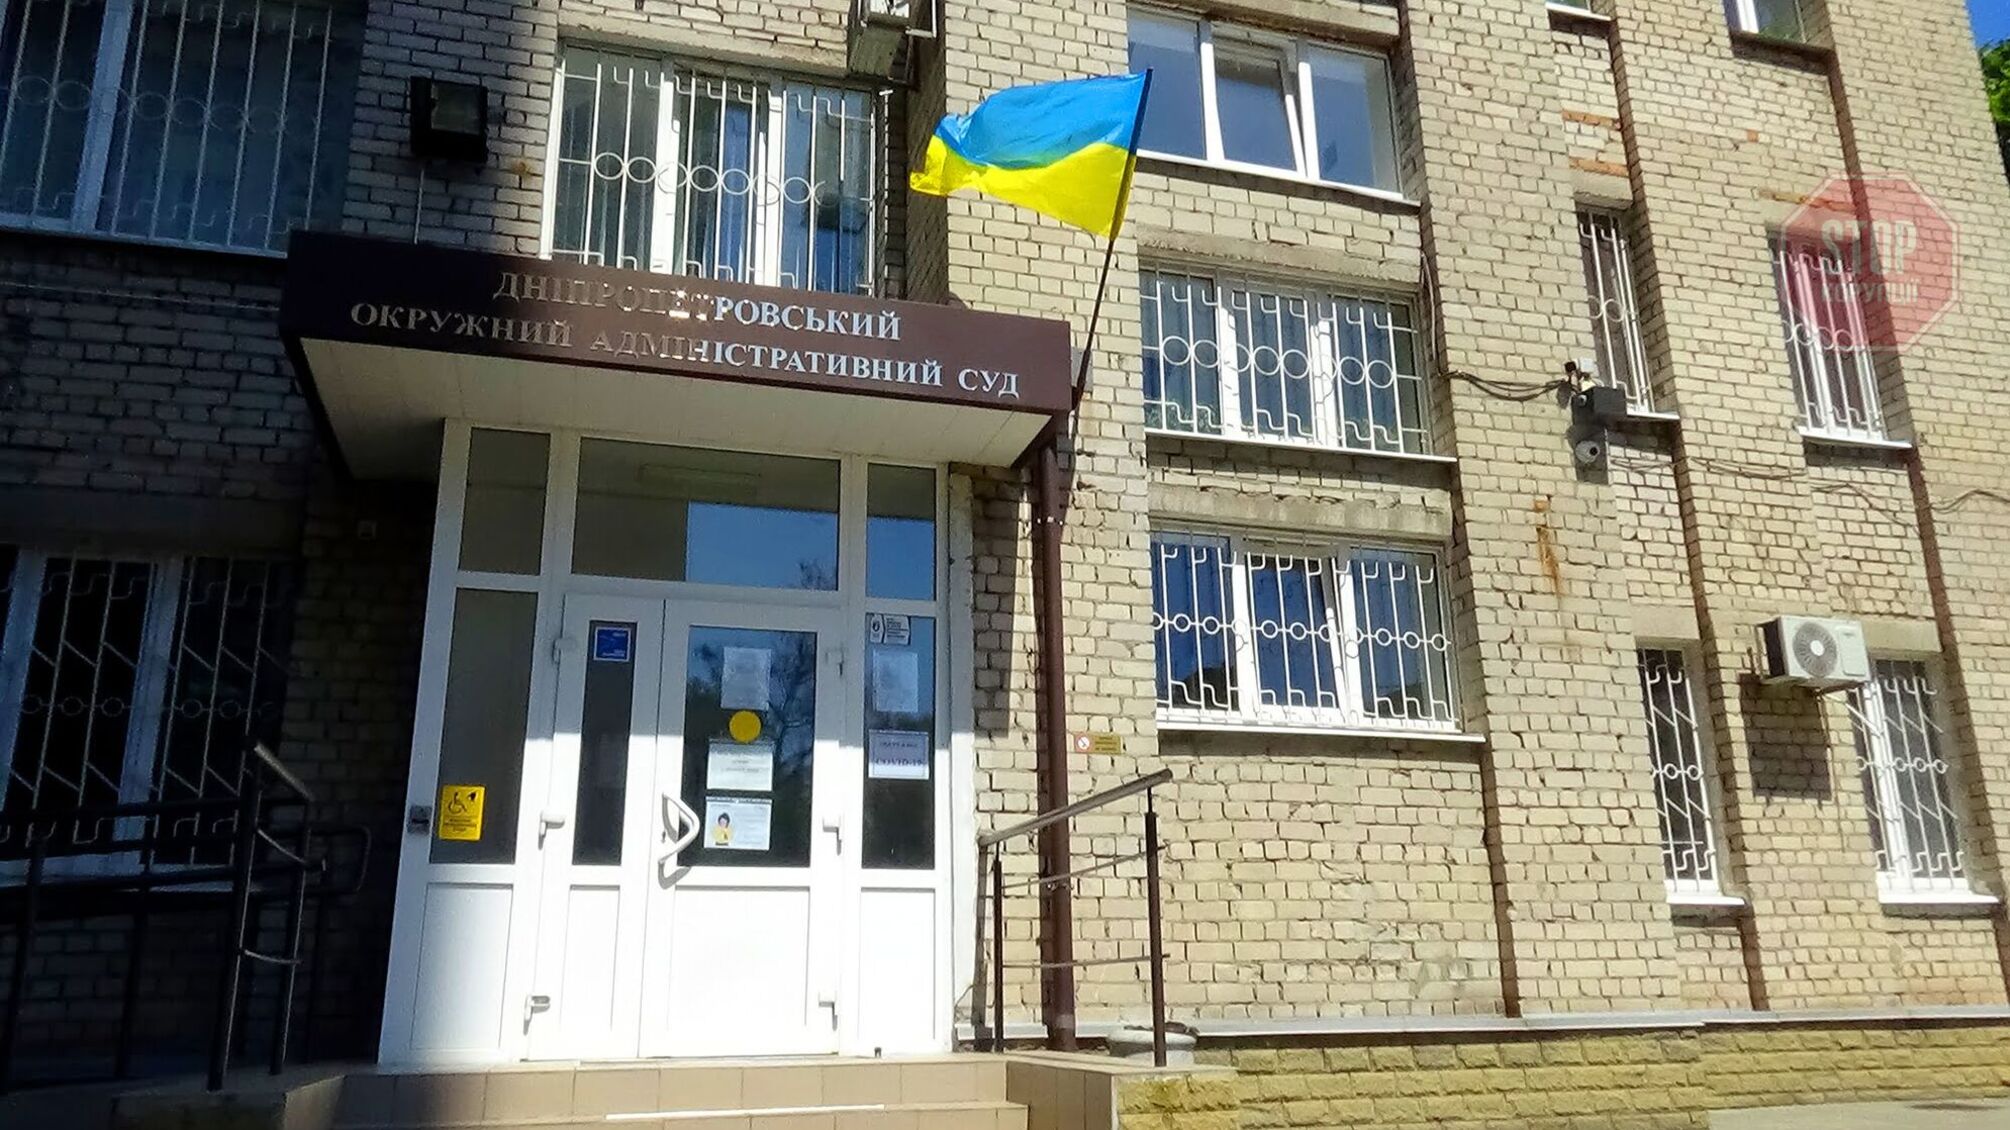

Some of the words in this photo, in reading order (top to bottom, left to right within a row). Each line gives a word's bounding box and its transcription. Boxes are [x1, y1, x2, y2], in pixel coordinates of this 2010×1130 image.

[493, 272, 901, 341] ДНІПРОПЕТРОВСЬКИЙ
[351, 302, 572, 348] ОКРУЖНИЙ
[590, 331, 943, 387] АДМІНІСТРАТИВНИЙ
[958, 369, 1019, 399] СУД
